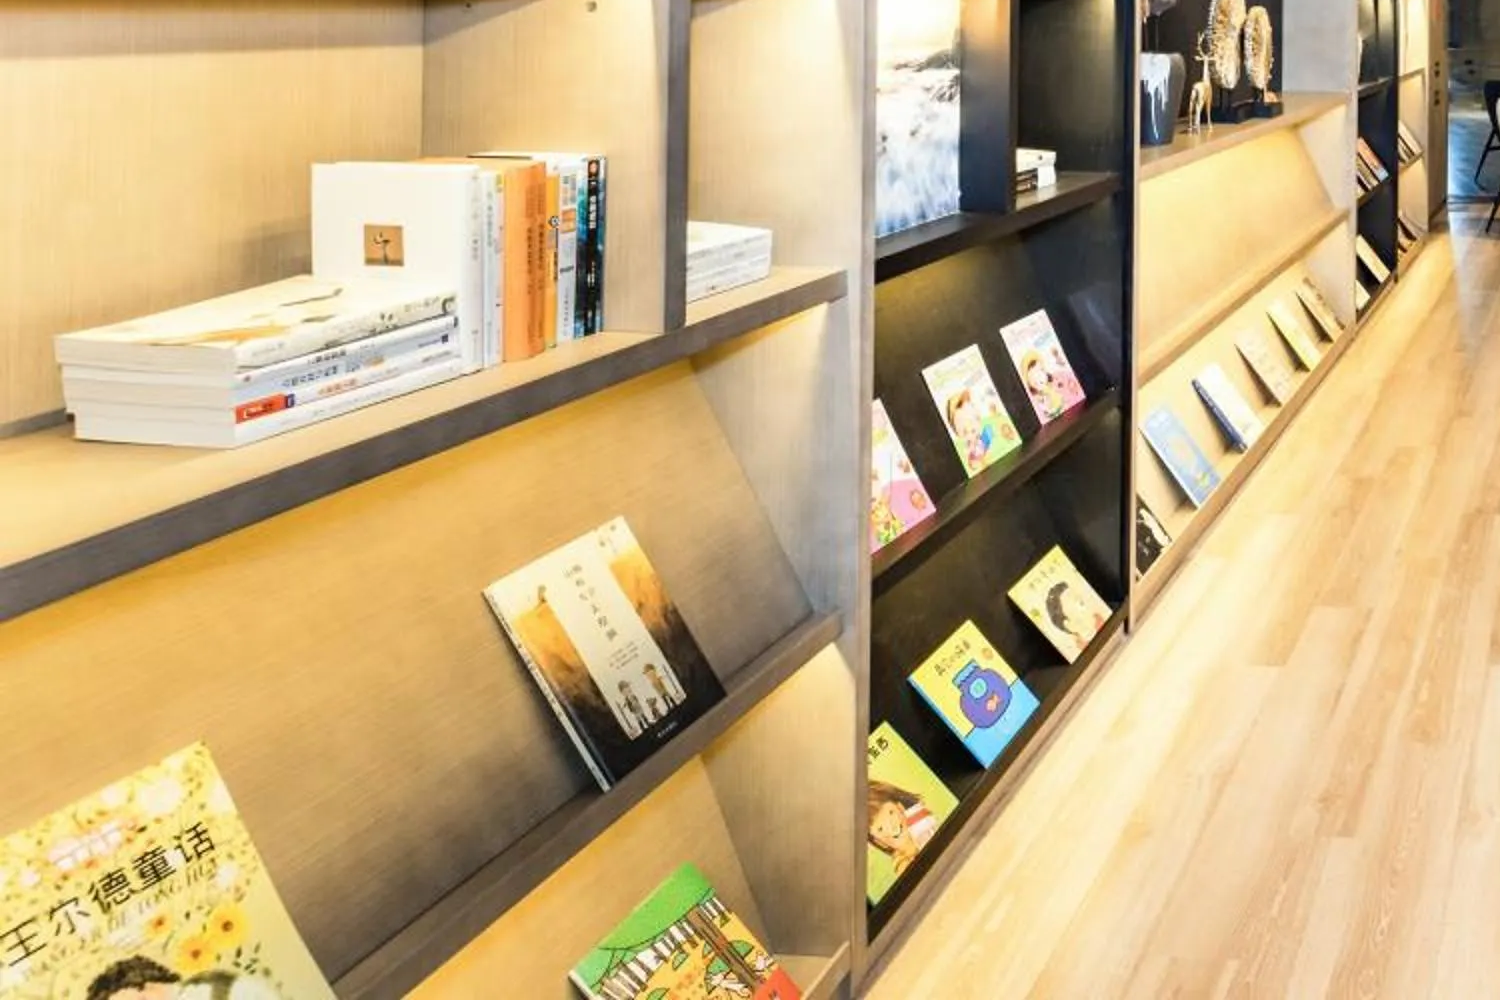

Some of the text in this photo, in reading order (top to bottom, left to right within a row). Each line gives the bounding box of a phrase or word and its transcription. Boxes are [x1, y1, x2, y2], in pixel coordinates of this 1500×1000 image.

[0, 821, 216, 967] 王尔德童话
